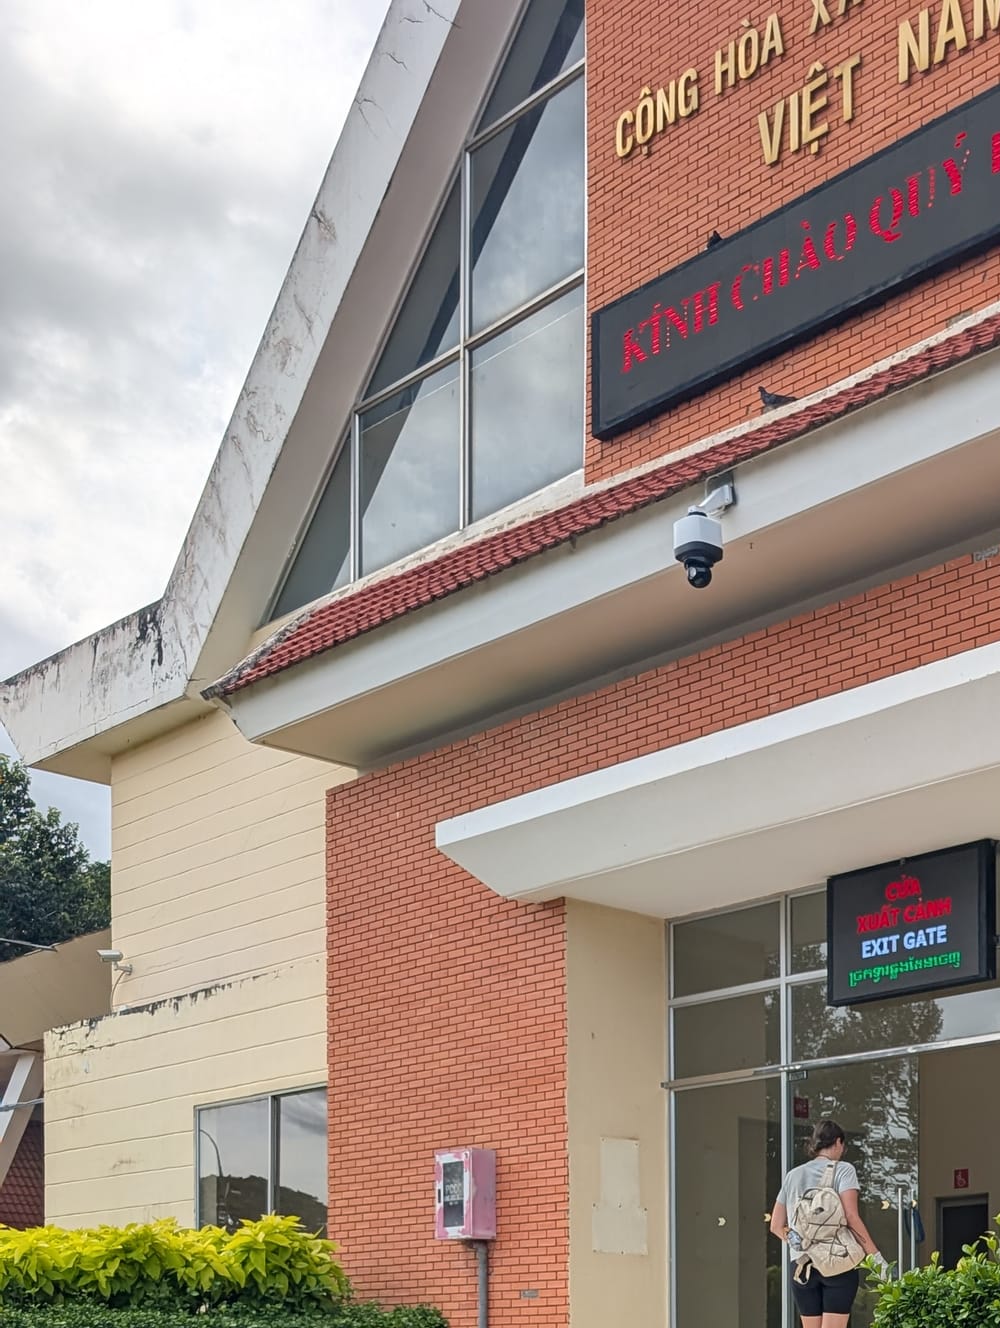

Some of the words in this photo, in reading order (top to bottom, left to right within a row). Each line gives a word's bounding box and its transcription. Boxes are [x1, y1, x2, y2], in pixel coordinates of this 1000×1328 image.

[615, 67, 699, 158] CỘNG
[714, 12, 785, 96] HÒA
[809, 0, 866, 35] X
[757, 53, 861, 167] VIỆT
[861, 934, 900, 959] EXIT
[903, 924, 948, 950] GATE
